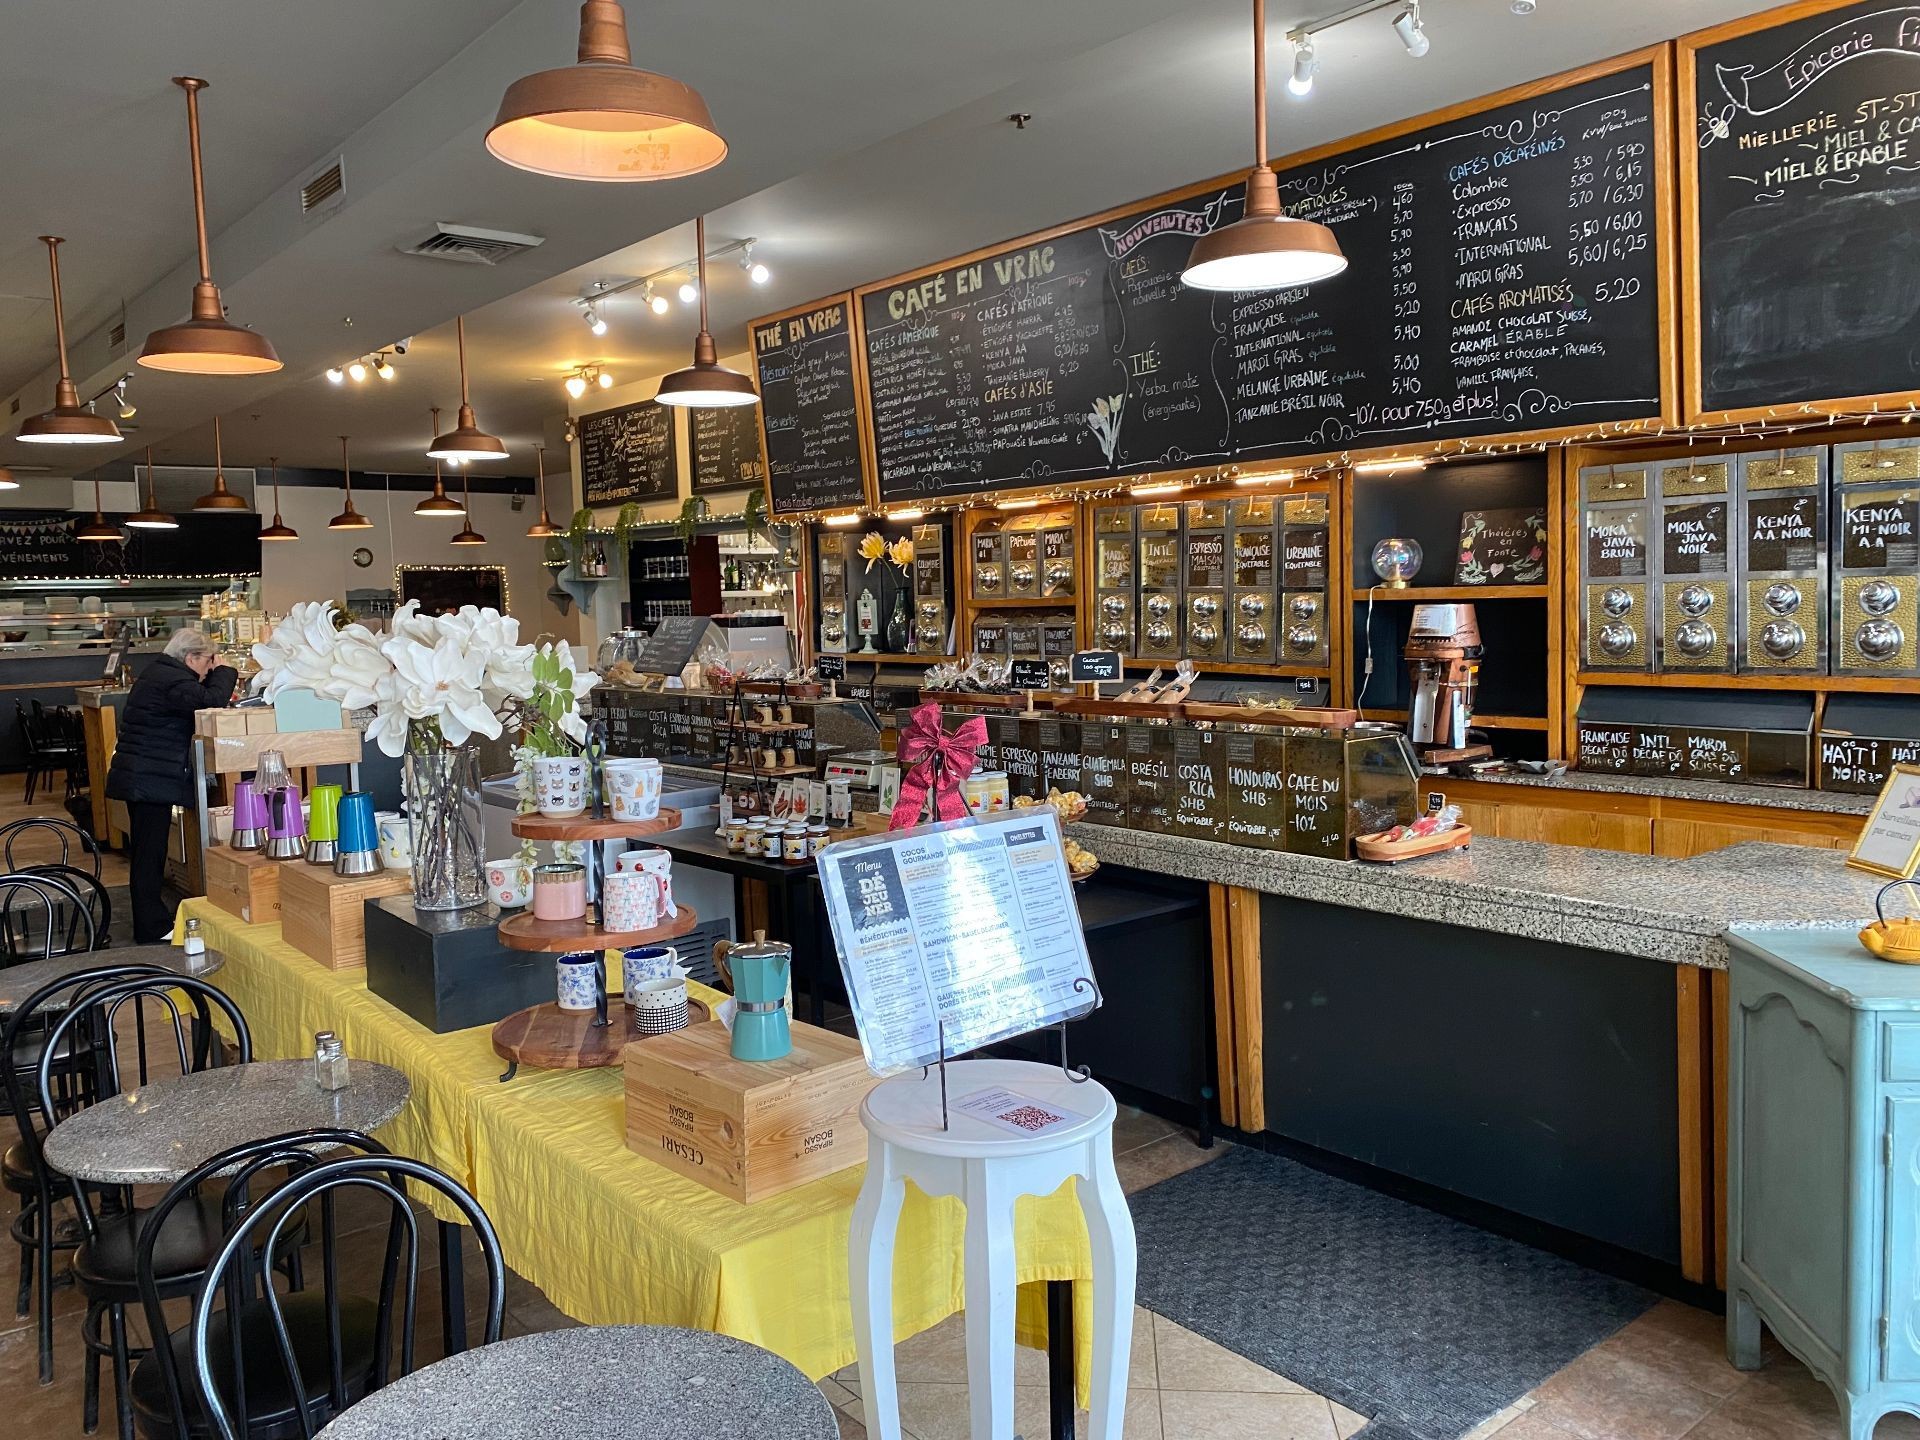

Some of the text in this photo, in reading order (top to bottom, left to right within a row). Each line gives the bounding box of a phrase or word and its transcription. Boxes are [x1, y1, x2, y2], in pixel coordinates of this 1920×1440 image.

[1783, 31, 1873, 90] Épicerie
[1877, 120, 1891, 142] &
[1449, 130, 1566, 182] CAFÉS DÉCAFÉINÉS
[1814, 154, 1828, 176] &
[1834, 139, 1909, 173] ÉRABLE
[1453, 176, 1509, 200] Colombie
[1457, 196, 1511, 219] Expresso
[1615, 161, 1643, 182] 6,15
[1458, 214, 1518, 240] FRANÇAIS
[1568, 190, 1594, 208] 5,70
[1116, 212, 1204, 255] NOUVEAUTÉS
[1459, 219, 1599, 265] INTERNATIONAL 5,50
[887, 246, 1056, 320] CAFÉ EN VRAC
[1459, 268, 1491, 289] MARDI
[1495, 264, 1524, 283] GRAS
[1132, 287, 1166, 307] nouvelle
[1450, 277, 1641, 320] CAFÉS AROMATISÉS 5,20
[977, 300, 1008, 322] CAFÉS
[1233, 299, 1274, 322] EXPRESSO
[757, 306, 841, 351] THÉ EN VRAC
[1234, 312, 1421, 341] FRANÇAISE 5,40
[1498, 311, 1554, 329] CHOCOLAT
[870, 332, 895, 353] CAFÉS
[1235, 330, 1305, 357] INTERNATIONAL
[1450, 324, 1568, 354] CARAMEL ÉRABLE
[986, 343, 1027, 360] KENYA AA
[1237, 355, 1270, 379] MARDI
[1274, 348, 1304, 370] GRAS
[1137, 373, 1198, 399] Yerba maté
[1284, 370, 1329, 391] URBAINE
[1392, 377, 1421, 394] 5,40
[1456, 374, 1488, 389] VANILLE
[984, 382, 1016, 403] CAFÉS
[1236, 393, 1345, 423] TANZANIE BRÉSIL NOIR
[1382, 402, 1416, 425] pour
[1452, 393, 1467, 412] et
[1757, 514, 1803, 528] KENYA
[1846, 507, 1903, 524] KENYA
[1590, 525, 1627, 538] MOKA
[1668, 520, 1705, 534] MOKA
[1782, 526, 1814, 539] NOIR
[1045, 532, 1064, 545] MARIA
[1500, 538, 1512, 546] en
[1603, 536, 1634, 548] JAVA
[1682, 532, 1717, 544] JAVA
[1189, 541, 1222, 555] ESPRESSO
[1235, 544, 1271, 562] FRANÇAISE
[1286, 545, 1323, 559] URBAINE
[1601, 548, 1636, 560] BRUN
[1678, 542, 1710, 554] NOIR
[1107, 561, 1130, 574] GRAS
[1192, 553, 1223, 565] MAISON
[979, 628, 997, 640] MARIA
[649, 711, 667, 722] COSTA
[1580, 729, 1631, 746] FRANÇAISE
[1640, 733, 1676, 749] INTL
[1688, 736, 1728, 752] MARDI
[1001, 746, 1038, 764] ESPRESSO
[1041, 751, 1081, 767] TANZANIE
[1690, 748, 1718, 761] GRAS
[1822, 741, 1877, 766] HAÏTI
[1083, 755, 1126, 772] GUATEMALA
[1132, 759, 1169, 778] BRÉSIL
[1689, 759, 1727, 774] SUISSE
[1047, 767, 1082, 782] EABERRY
[1094, 773, 1113, 787] SHB
[1178, 764, 1212, 783] COSTA
[1229, 767, 1282, 790] HONDURAS
[1832, 765, 1866, 784] NOIR
[1189, 781, 1215, 799] RICA
[1322, 778, 1339, 792] DU
[1180, 796, 1206, 811] SHB
[1296, 795, 1327, 811] MOIS
[901, 848, 925, 858] COCOS
[902, 851, 944, 865] GOURMANDS
[855, 861, 882, 873] Menu
[859, 871, 885, 895] DÉ
[862, 891, 888, 906] JEU
[864, 902, 893, 917] NER
[860, 927, 907, 945] BÉNÉDICTINES
[938, 998, 959, 1010] DORÉS
[669, 1104, 694, 1122] BOSAN
[804, 1129, 833, 1147] BOSAN
[661, 1135, 704, 1166] CESARI
